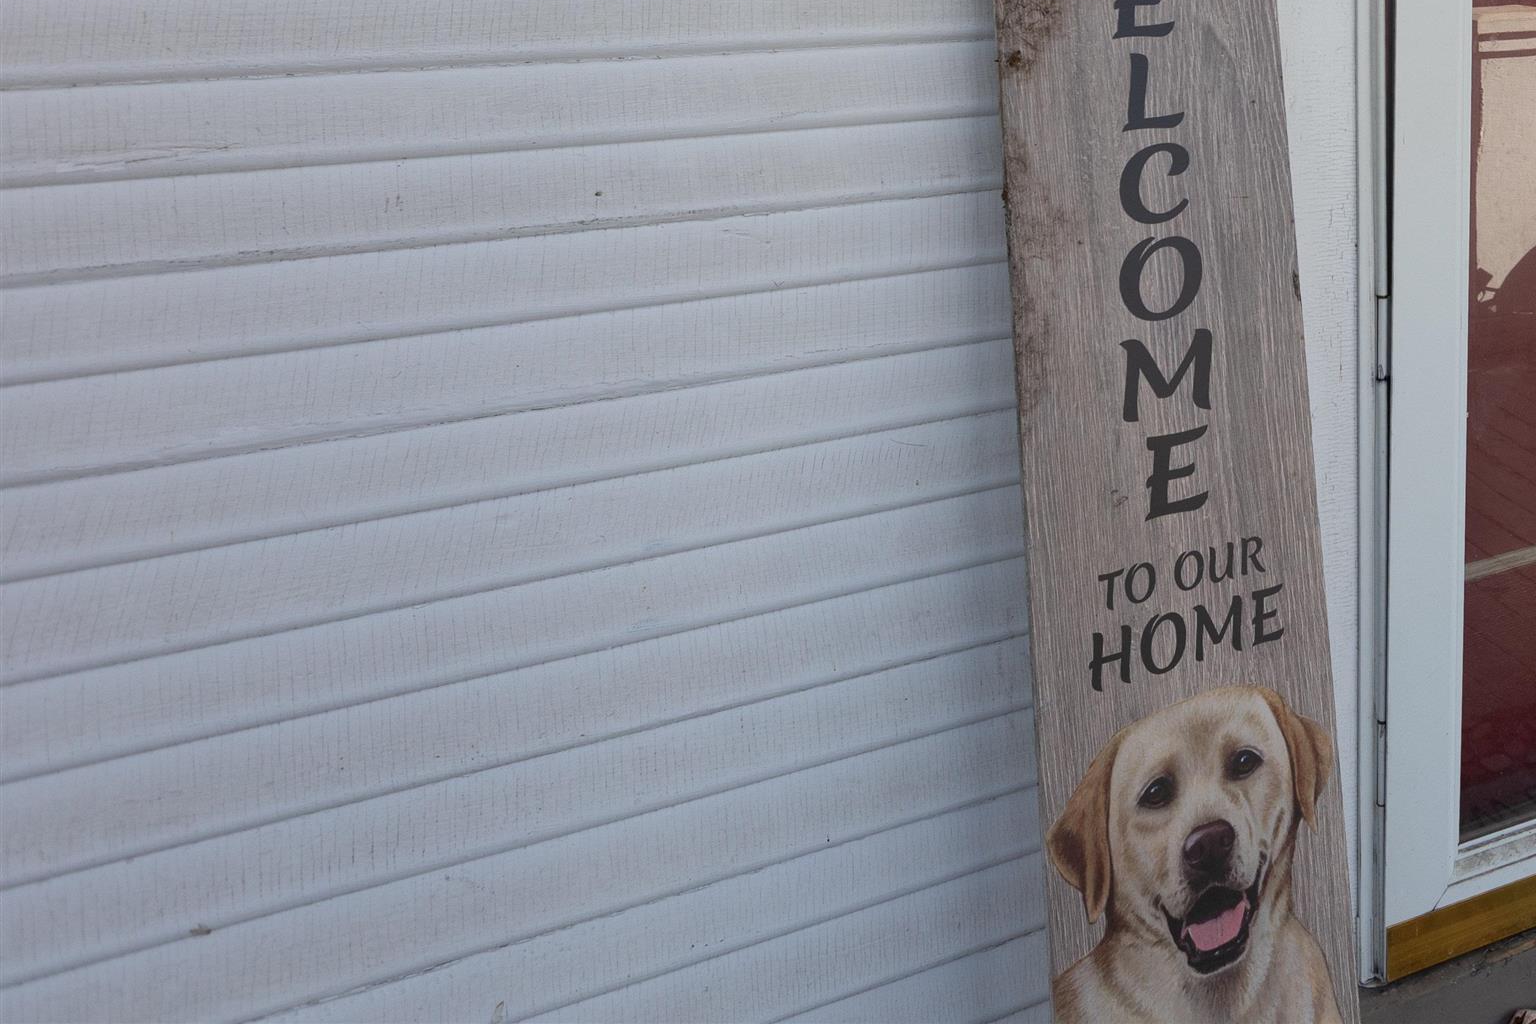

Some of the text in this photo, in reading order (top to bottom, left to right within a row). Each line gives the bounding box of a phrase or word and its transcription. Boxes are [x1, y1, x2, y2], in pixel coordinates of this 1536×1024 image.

[1098, 535, 1266, 611] TO OUR
[1089, 583, 1285, 692] HOME
